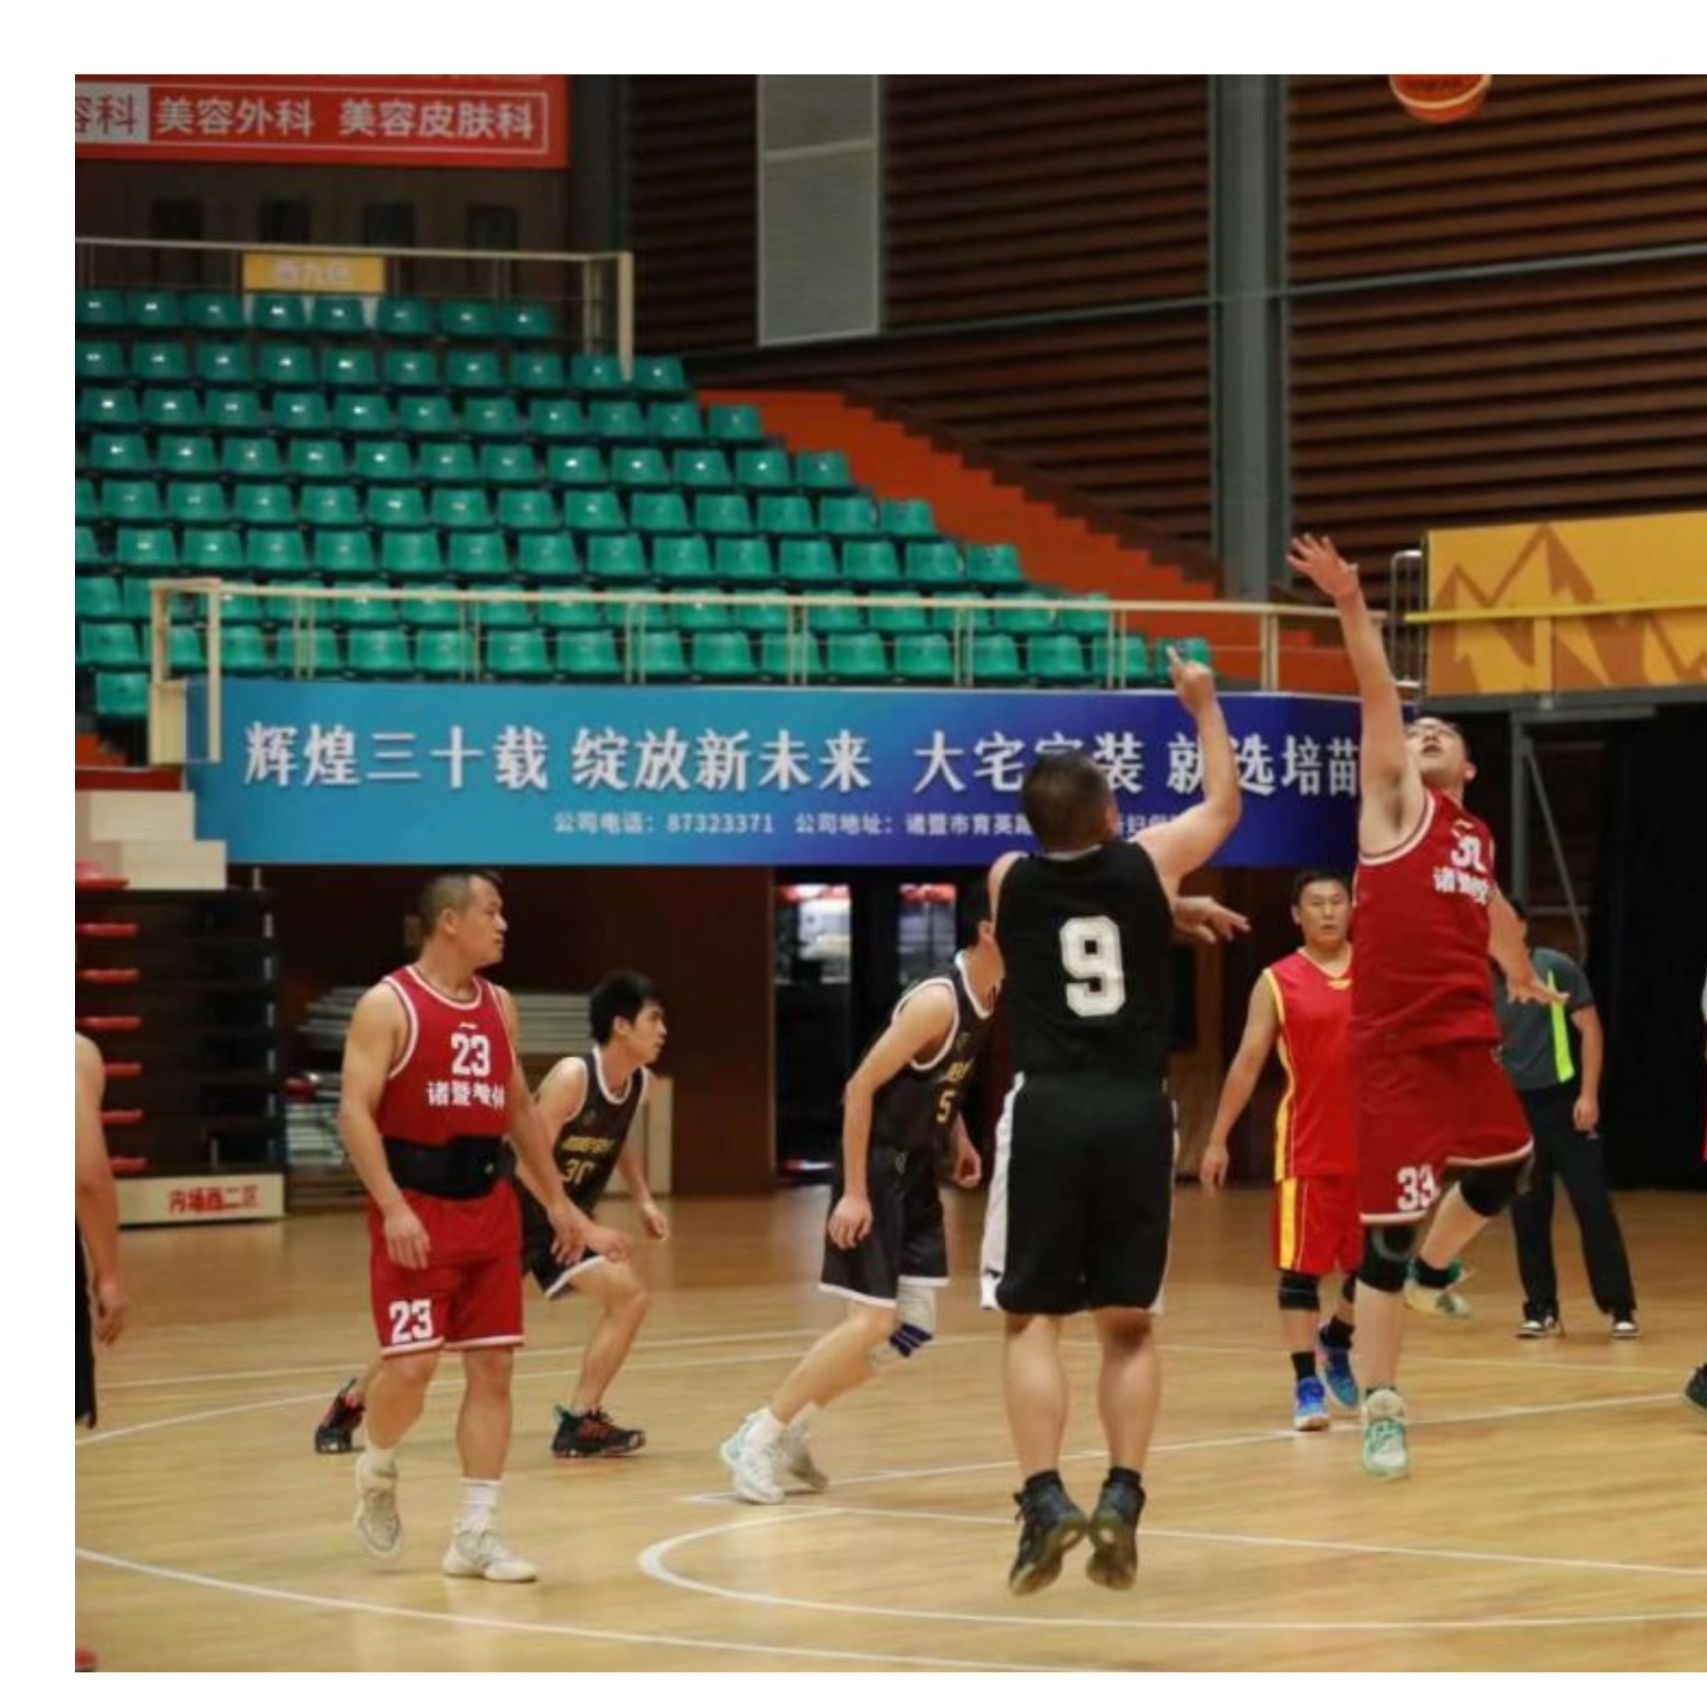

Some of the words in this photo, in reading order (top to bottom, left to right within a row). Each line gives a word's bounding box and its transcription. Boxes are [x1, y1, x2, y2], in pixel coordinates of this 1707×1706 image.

[157, 96, 315, 137] 美容外科
[339, 97, 535, 139] 美容皮肤科
[244, 720, 549, 790] 辉煌三十载
[571, 725, 873, 793] 绽放新未来
[912, 728, 1145, 794] 大宅装
[1059, 914, 1127, 1018] 9
[450, 1032, 492, 1077] 23
[388, 1299, 434, 1345] 23
